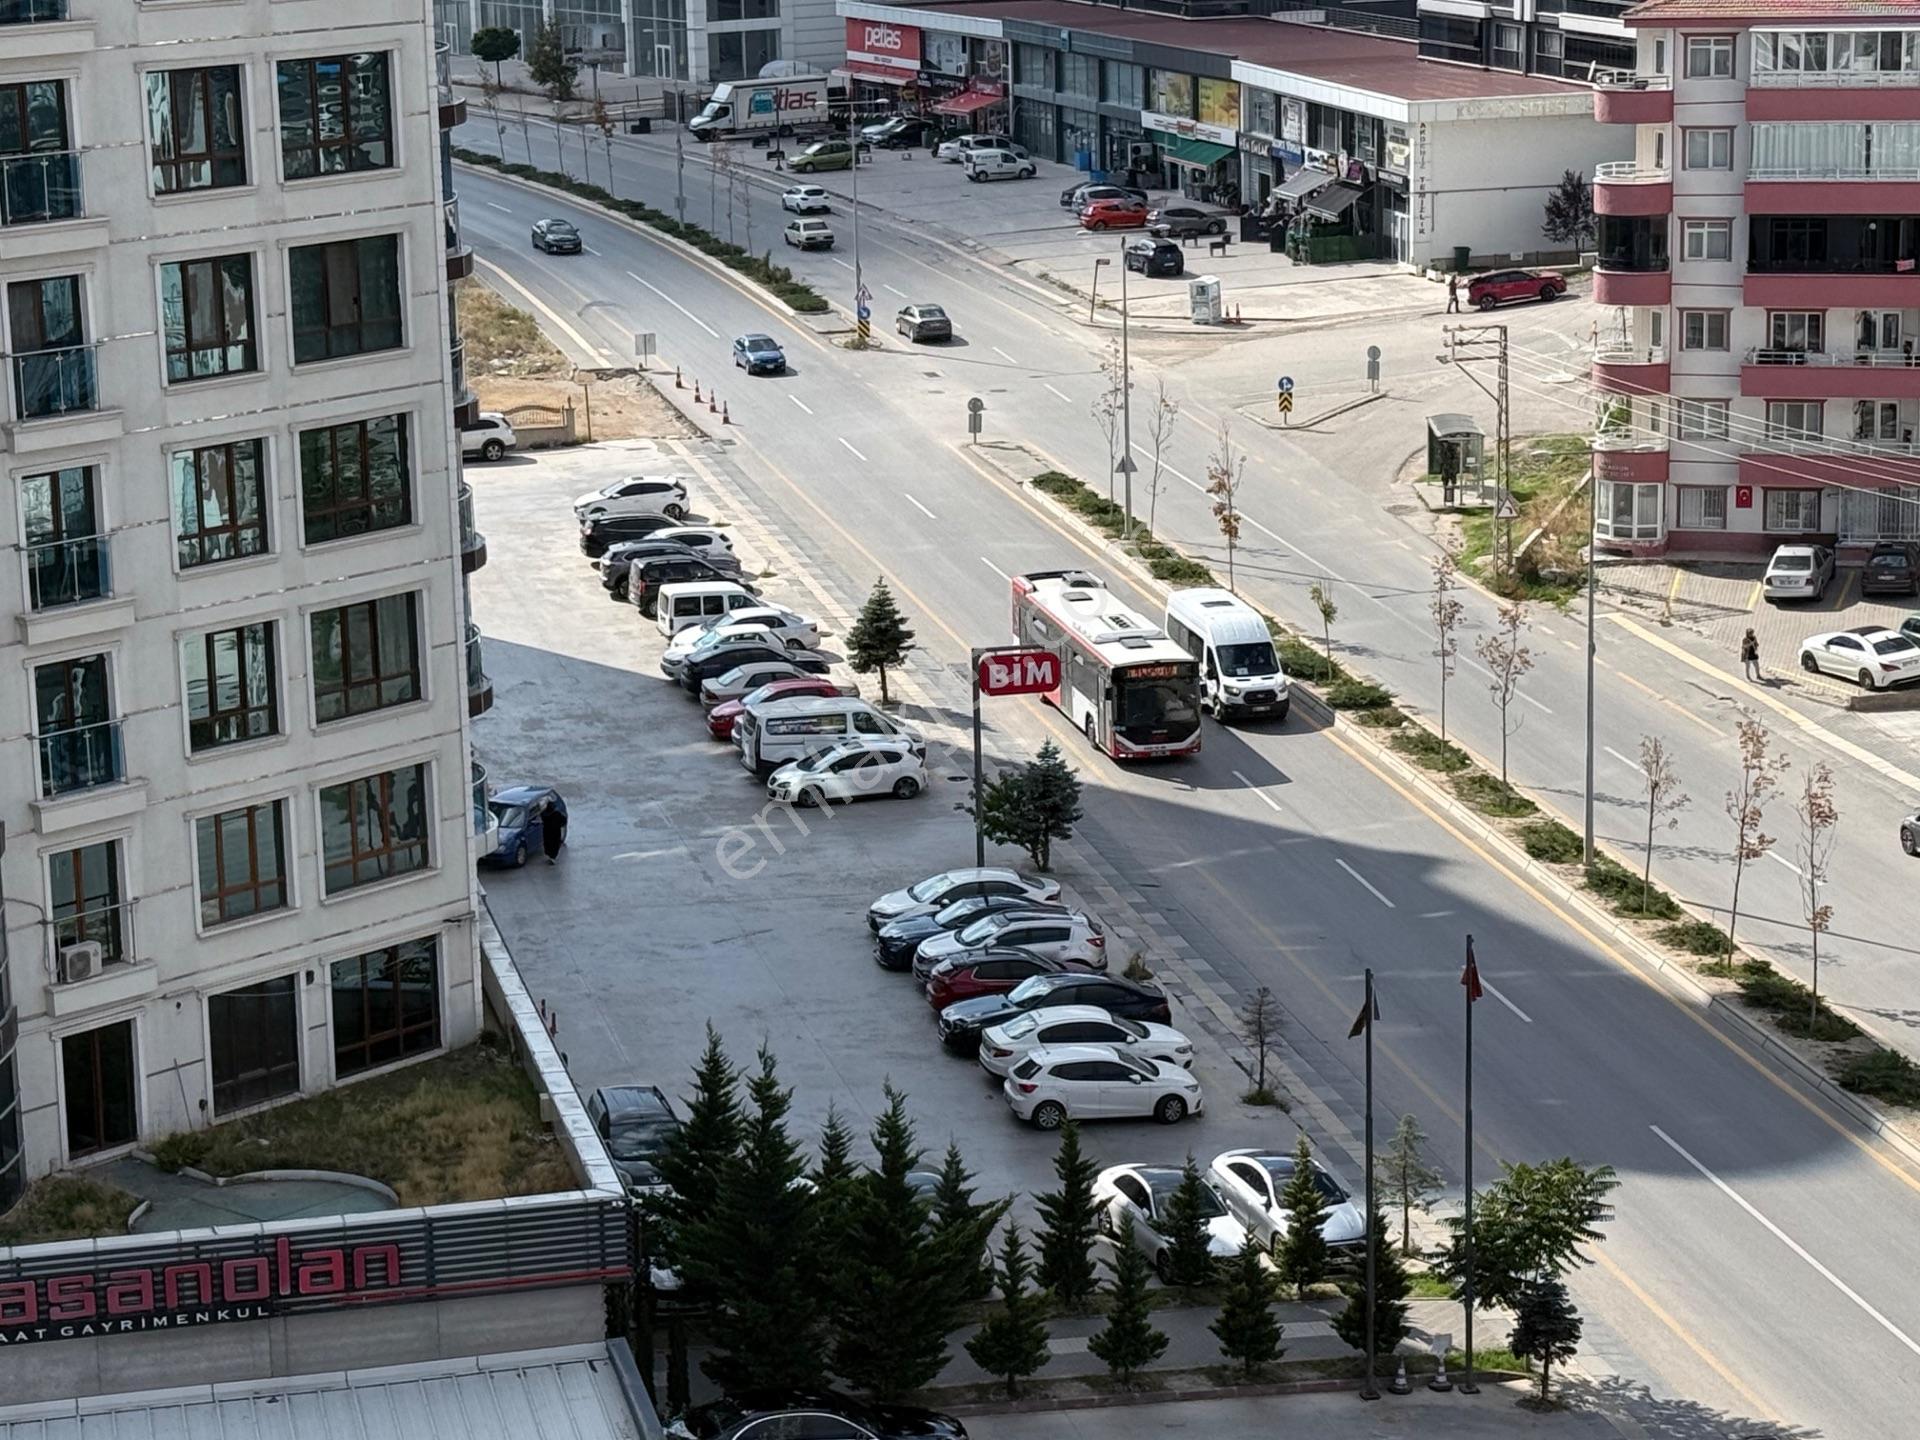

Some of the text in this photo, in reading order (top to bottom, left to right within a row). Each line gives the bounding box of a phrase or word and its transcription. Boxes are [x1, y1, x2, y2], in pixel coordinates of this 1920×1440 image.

[864, 24, 902, 51] petlas
[989, 656, 1053, 689] BİM
[60, 1306, 270, 1338] GAYRİMENKUL
